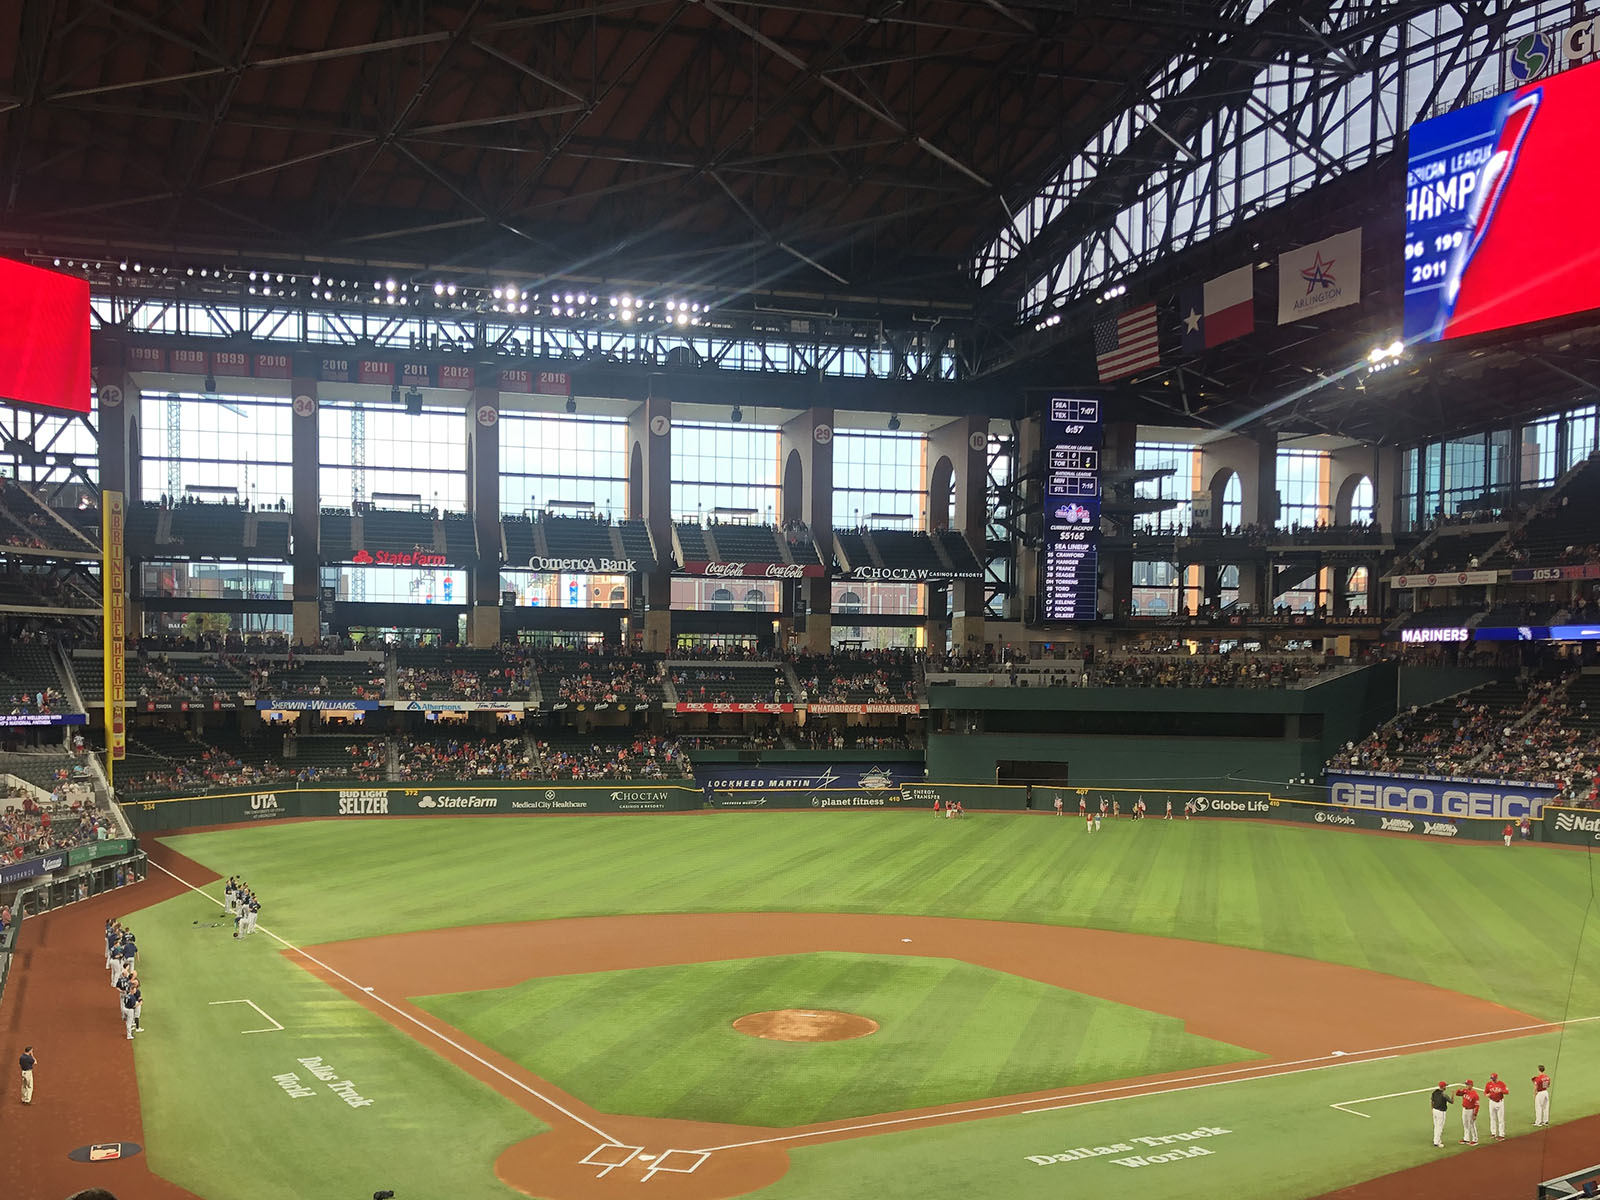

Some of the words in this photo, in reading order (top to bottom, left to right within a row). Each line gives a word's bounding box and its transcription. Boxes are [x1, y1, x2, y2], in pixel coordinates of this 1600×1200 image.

[1406, 168, 1480, 222] HAMP
[1412, 260, 1447, 283] 2011
[1294, 288, 1342, 311] ARLINGTON
[131, 348, 159, 360] 1996
[175, 350, 203, 362] 1998
[217, 352, 245, 365] 1999
[260, 355, 287, 367] 2010
[322, 359, 348, 370] 2010
[364, 361, 388, 373] 2011
[404, 364, 428, 376] 2011
[444, 366, 469, 378] 2012
[501, 370, 527, 382] 2015
[541, 373, 566, 384] 2016
[101, 390, 120, 403] 42
[295, 399, 314, 413] 34
[1080, 407, 1095, 415] 7:07
[479, 411, 496, 422] 26
[656, 420, 664, 432] 7
[1065, 425, 1084, 434] 6:57
[816, 428, 830, 441] 29
[973, 435, 984, 446] 10
[1060, 532, 1084, 540] $5165
[113, 515, 122, 589] BRING
[376, 550, 411, 565] State
[412, 551, 447, 566] Farm
[599, 558, 637, 572] Bank
[705, 561, 745, 578] Coca-Cola
[765, 563, 805, 579] Coca-Cola
[861, 566, 928, 579] CHOCTAW
[1532, 569, 1560, 580] 105.3
[113, 593, 122, 637] THE
[1325, 617, 1381, 625] PLUCKERS
[1402, 629, 1469, 642] MARINERS
[113, 642, 122, 700] HEAT
[421, 703, 462, 711] Albertsons
[475, 702, 488, 710] Tom
[488, 702, 511, 710] Thumb
[811, 704, 861, 713] WHATABURGER
[865, 704, 916, 713] WHATABURGER
[707, 779, 765, 788] LOCKHEED
[768, 779, 810, 787] MARTIN
[340, 791, 359, 799] BUD
[615, 791, 668, 801] CHOCTAW
[1331, 782, 1435, 814] GEICO
[250, 794, 278, 810] UTA
[338, 798, 389, 815] SELTZER
[437, 796, 467, 808] State
[468, 796, 497, 808] Farm
[511, 800, 538, 808] Medical
[538, 800, 552, 809] City
[552, 800, 587, 808] Healthcare
[821, 797, 852, 808] planet
[852, 797, 884, 806] fitness
[1211, 799, 1246, 812] Globe
[1247, 800, 1269, 812] Life
[1327, 814, 1356, 825] Kubota
[272, 1072, 317, 1098] World
[296, 1056, 338, 1081] Dallas
[327, 1079, 375, 1108] Truck
[1024, 1142, 1134, 1166] Dallas
[1129, 1126, 1232, 1147] Truck
[1109, 1145, 1216, 1168] World
